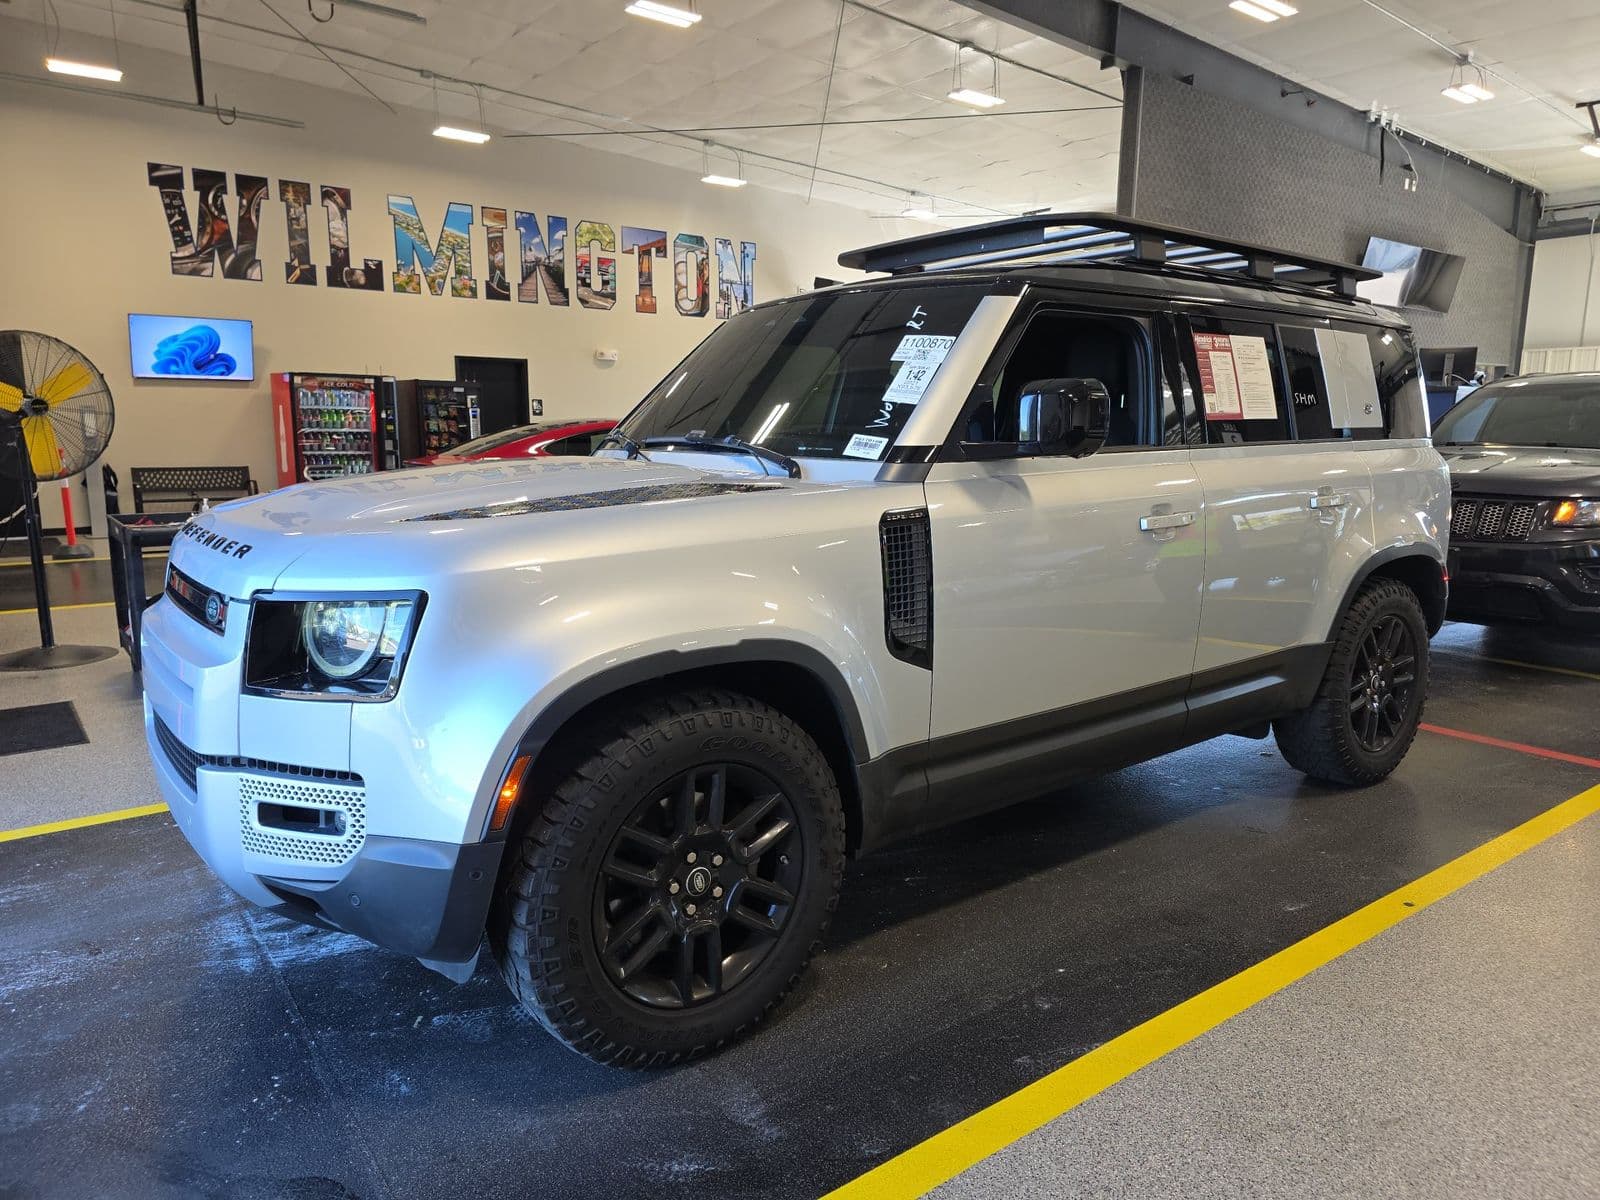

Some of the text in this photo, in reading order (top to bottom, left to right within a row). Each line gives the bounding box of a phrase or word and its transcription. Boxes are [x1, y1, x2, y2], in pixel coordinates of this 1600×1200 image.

[147, 161, 757, 320] WILMINGTON
[903, 337, 954, 350] 1100870
[905, 369, 926, 381] 1:42
